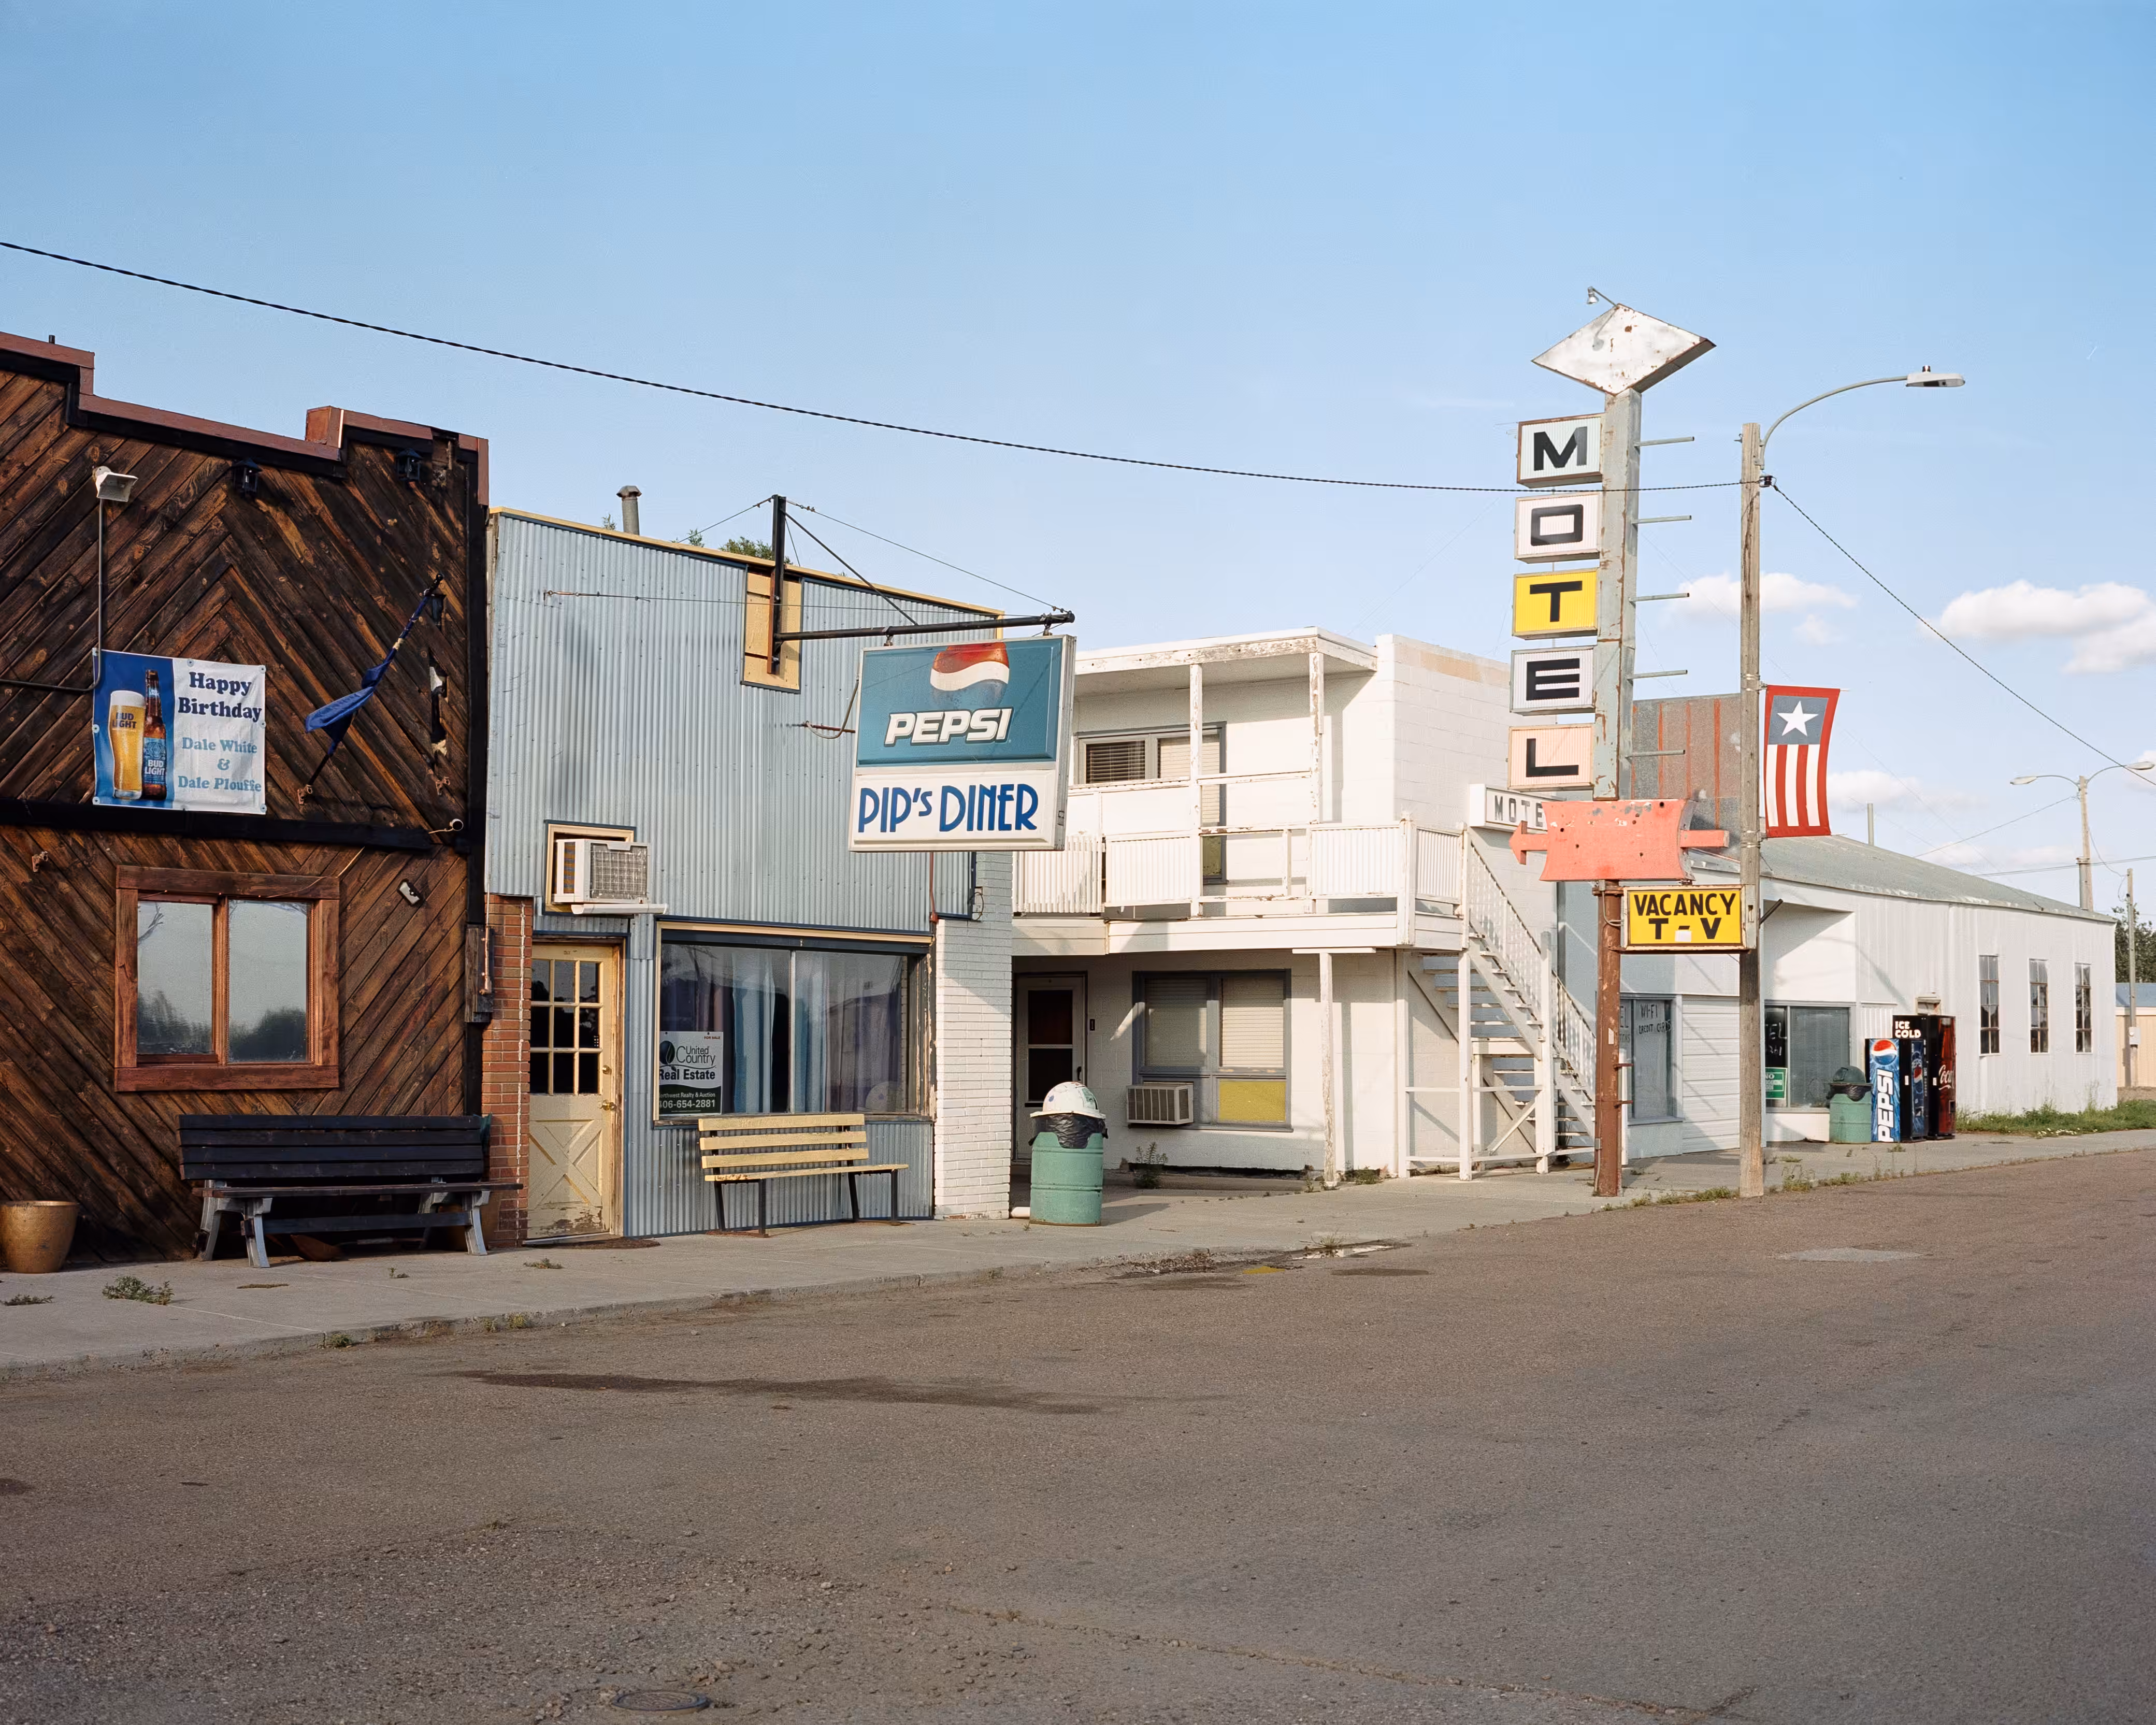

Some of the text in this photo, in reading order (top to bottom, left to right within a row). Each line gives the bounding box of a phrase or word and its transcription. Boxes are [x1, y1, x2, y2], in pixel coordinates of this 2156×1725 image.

[1526, 426, 1588, 778] MOTEL
[189, 671, 252, 696] Happy
[178, 697, 262, 723] Birthday
[112, 720, 137, 729] LIGHT
[884, 707, 1013, 747] PEPSI
[182, 737, 257, 754] Dale White
[145, 766, 165, 775] LIGHT
[148, 759, 164, 768] BUD
[217, 758, 231, 771] &
[178, 775, 262, 792] Dale Plouffe
[939, 783, 1039, 832] DINER
[1494, 795, 1543, 827] MOTE
[1634, 893, 1736, 916] VACANCY
[1894, 1020, 1910, 1030] ICE
[1894, 1029, 1921, 1039] COLD
[676, 1046, 716, 1066] Country
[685, 1045, 710, 1055] United
[659, 1069, 715, 1080] Real Estate
[1877, 1069, 1894, 1142] PEPSI
